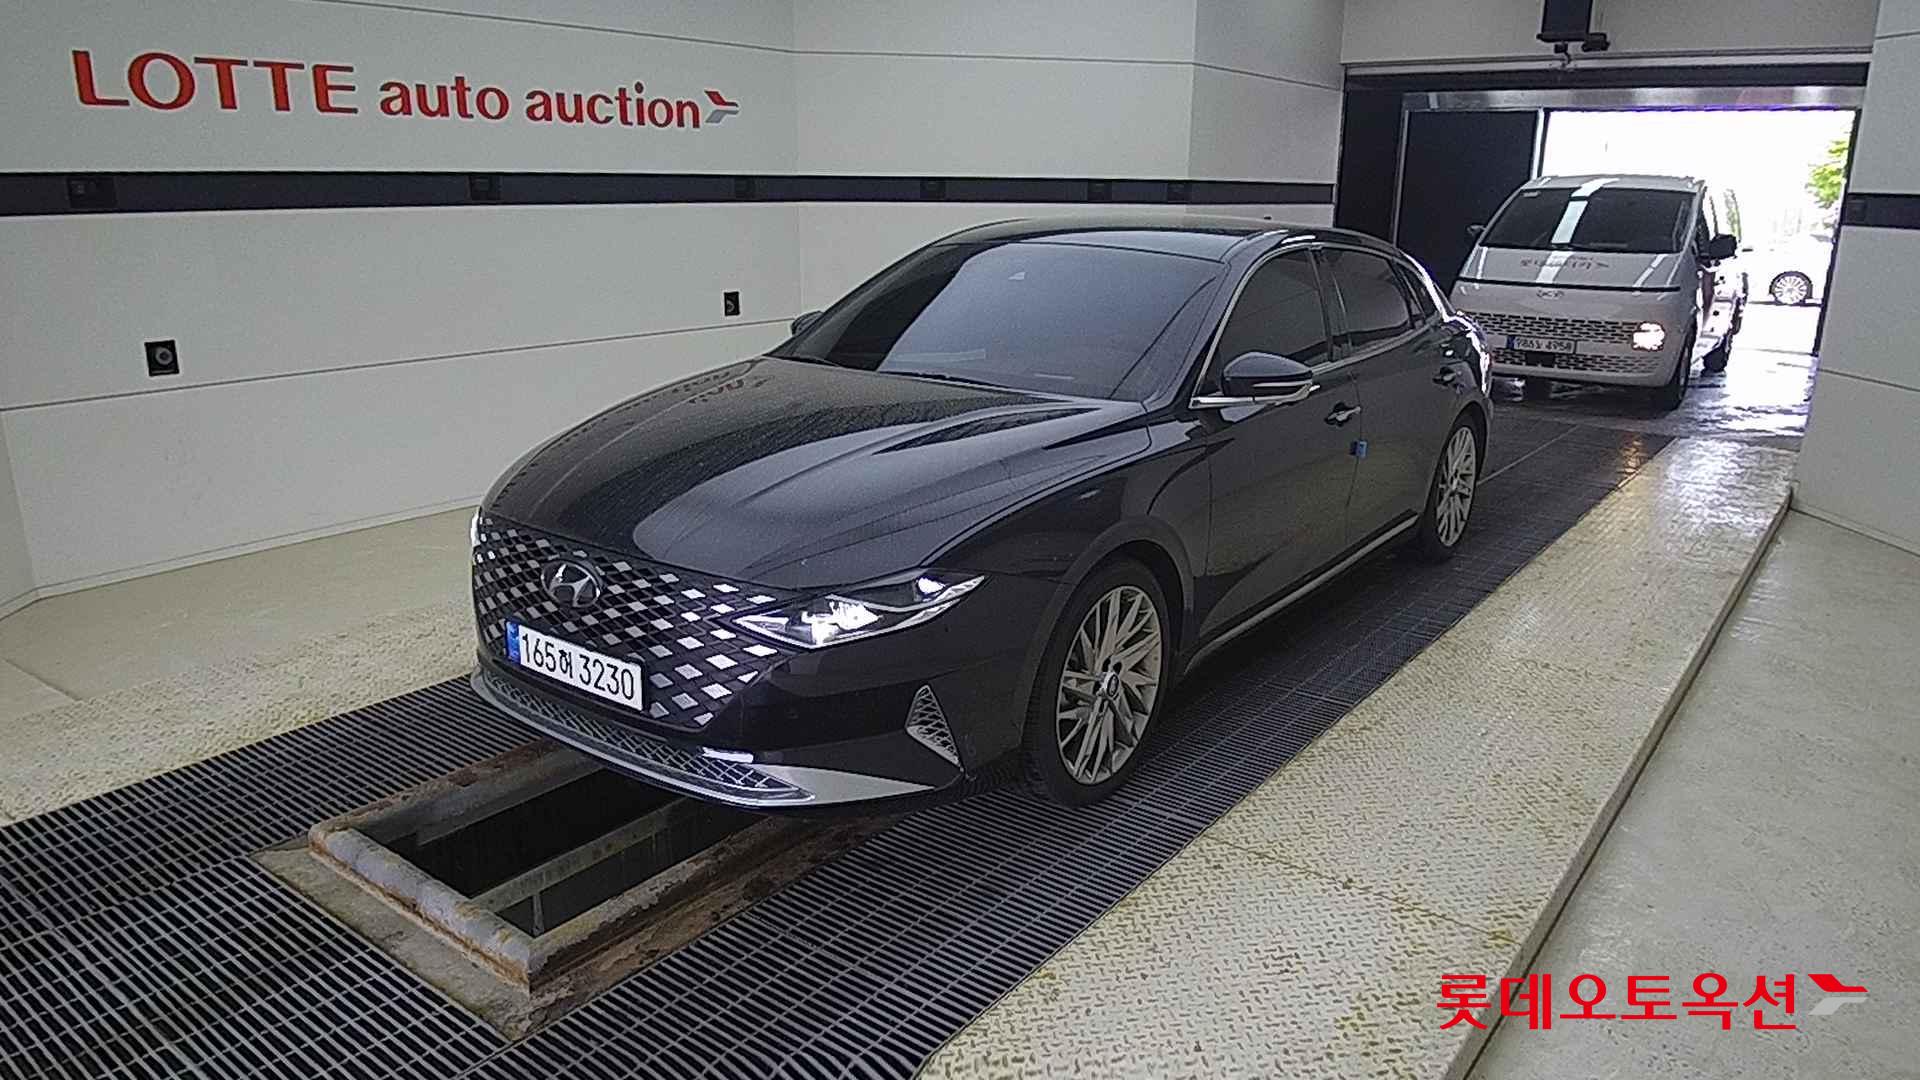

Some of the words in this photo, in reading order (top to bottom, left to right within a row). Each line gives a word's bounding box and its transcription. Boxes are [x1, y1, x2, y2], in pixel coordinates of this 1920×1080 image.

[74, 50, 359, 115] LOTTE
[379, 75, 511, 121] auto
[525, 81, 701, 129] auction
[578, 653, 635, 701] 3230
